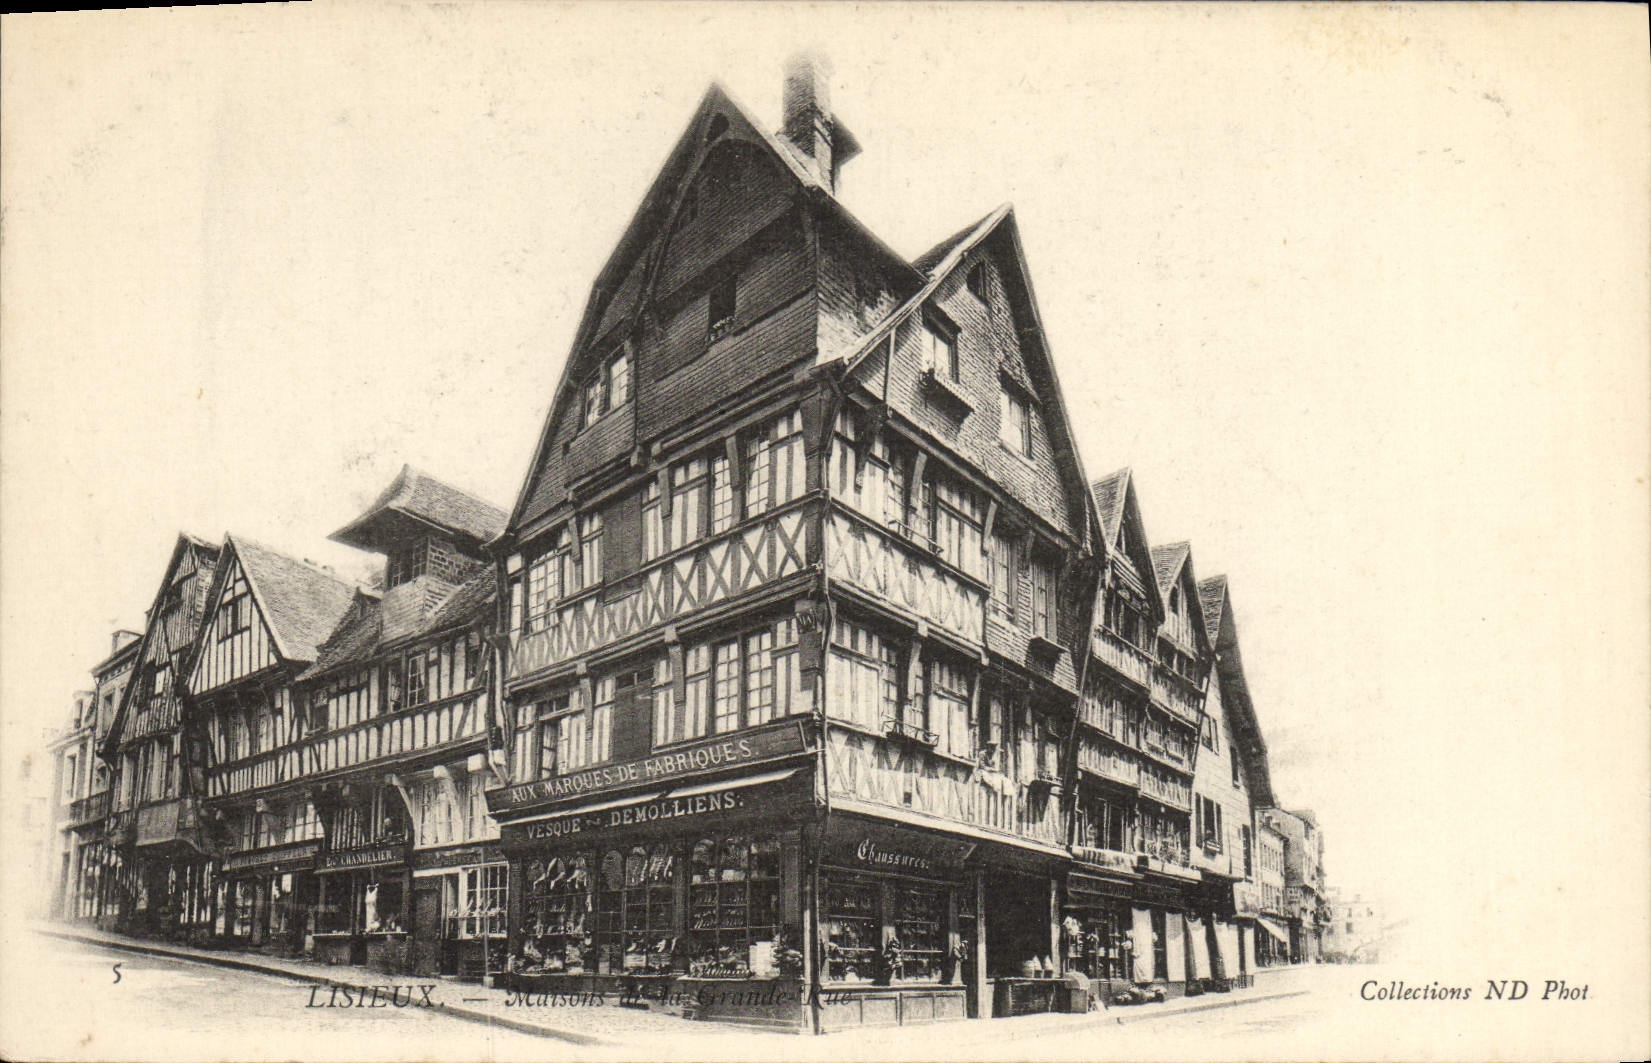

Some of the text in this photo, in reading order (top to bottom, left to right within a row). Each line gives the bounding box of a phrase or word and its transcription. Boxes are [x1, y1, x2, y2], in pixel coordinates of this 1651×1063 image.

[512, 739, 760, 803] AUX MARQUES DE FABRIQUES.
[527, 818, 581, 839] VESQUE
